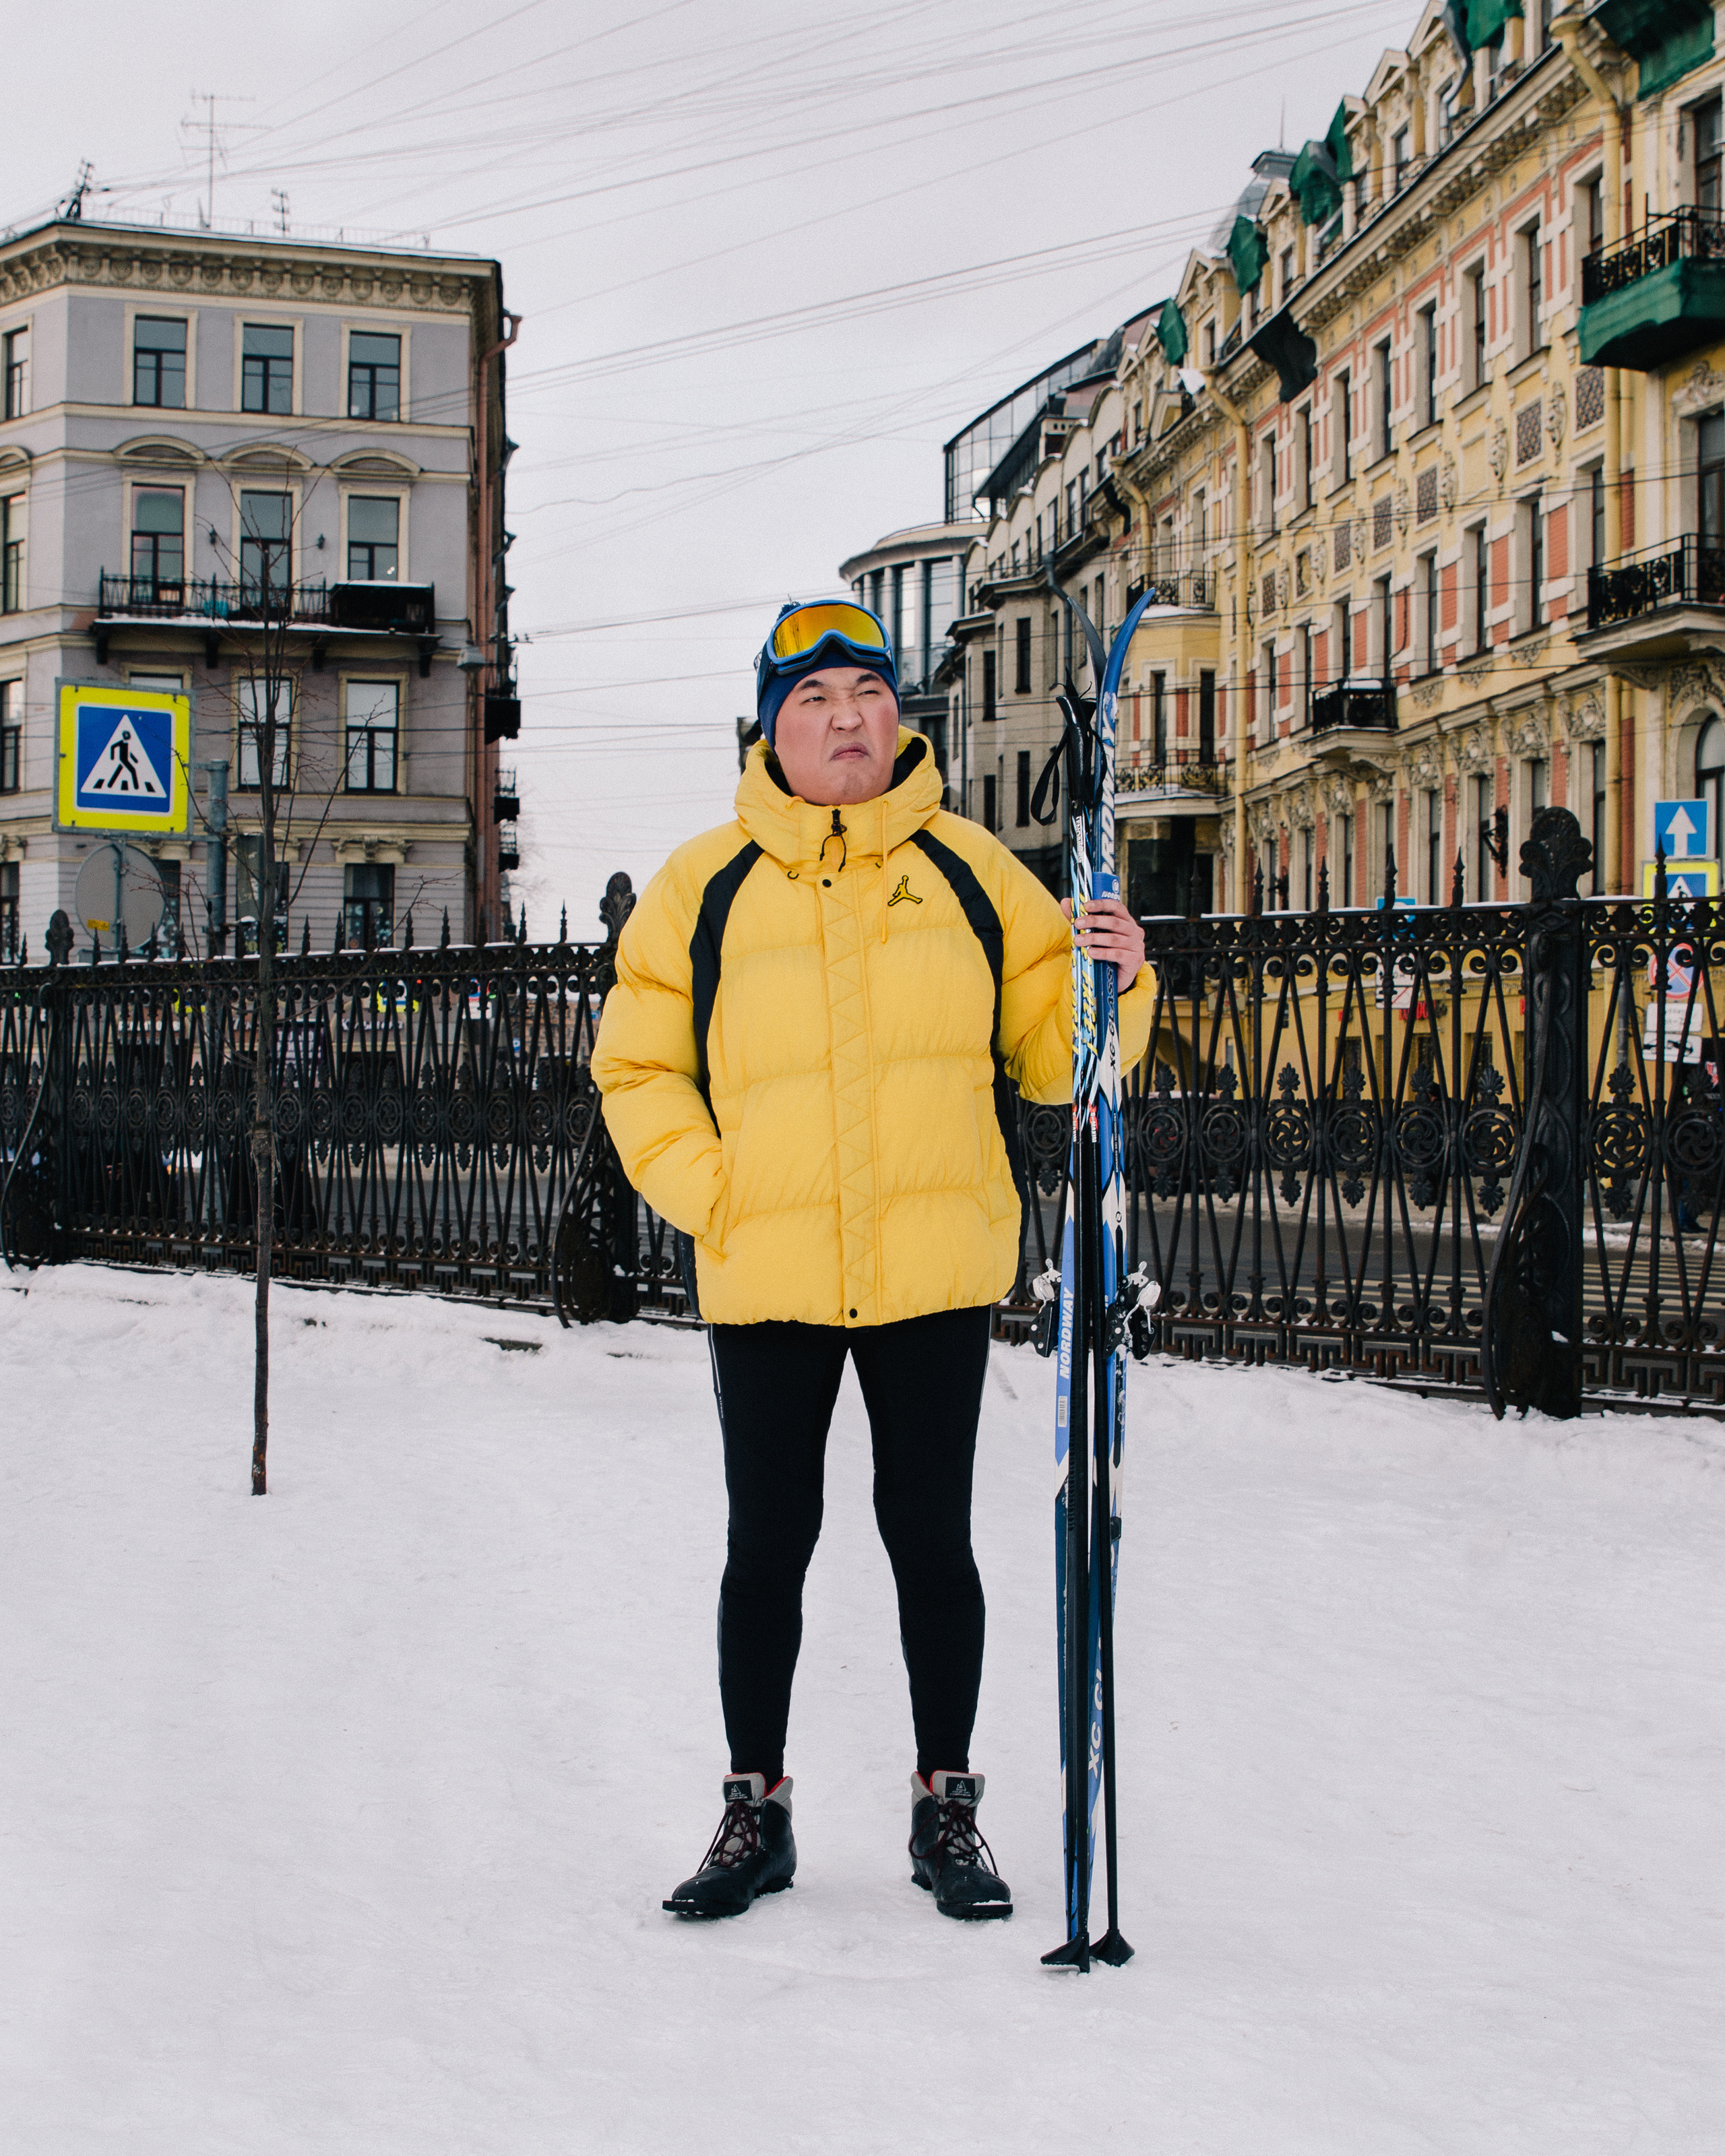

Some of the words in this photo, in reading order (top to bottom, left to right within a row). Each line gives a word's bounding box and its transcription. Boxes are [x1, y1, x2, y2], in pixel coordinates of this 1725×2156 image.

[1101, 891, 1120, 900] NORD
[1109, 1042, 1116, 1072] XC
[1060, 1286, 1074, 1379] NORDWAY
[1088, 1721, 1102, 1779] XC
